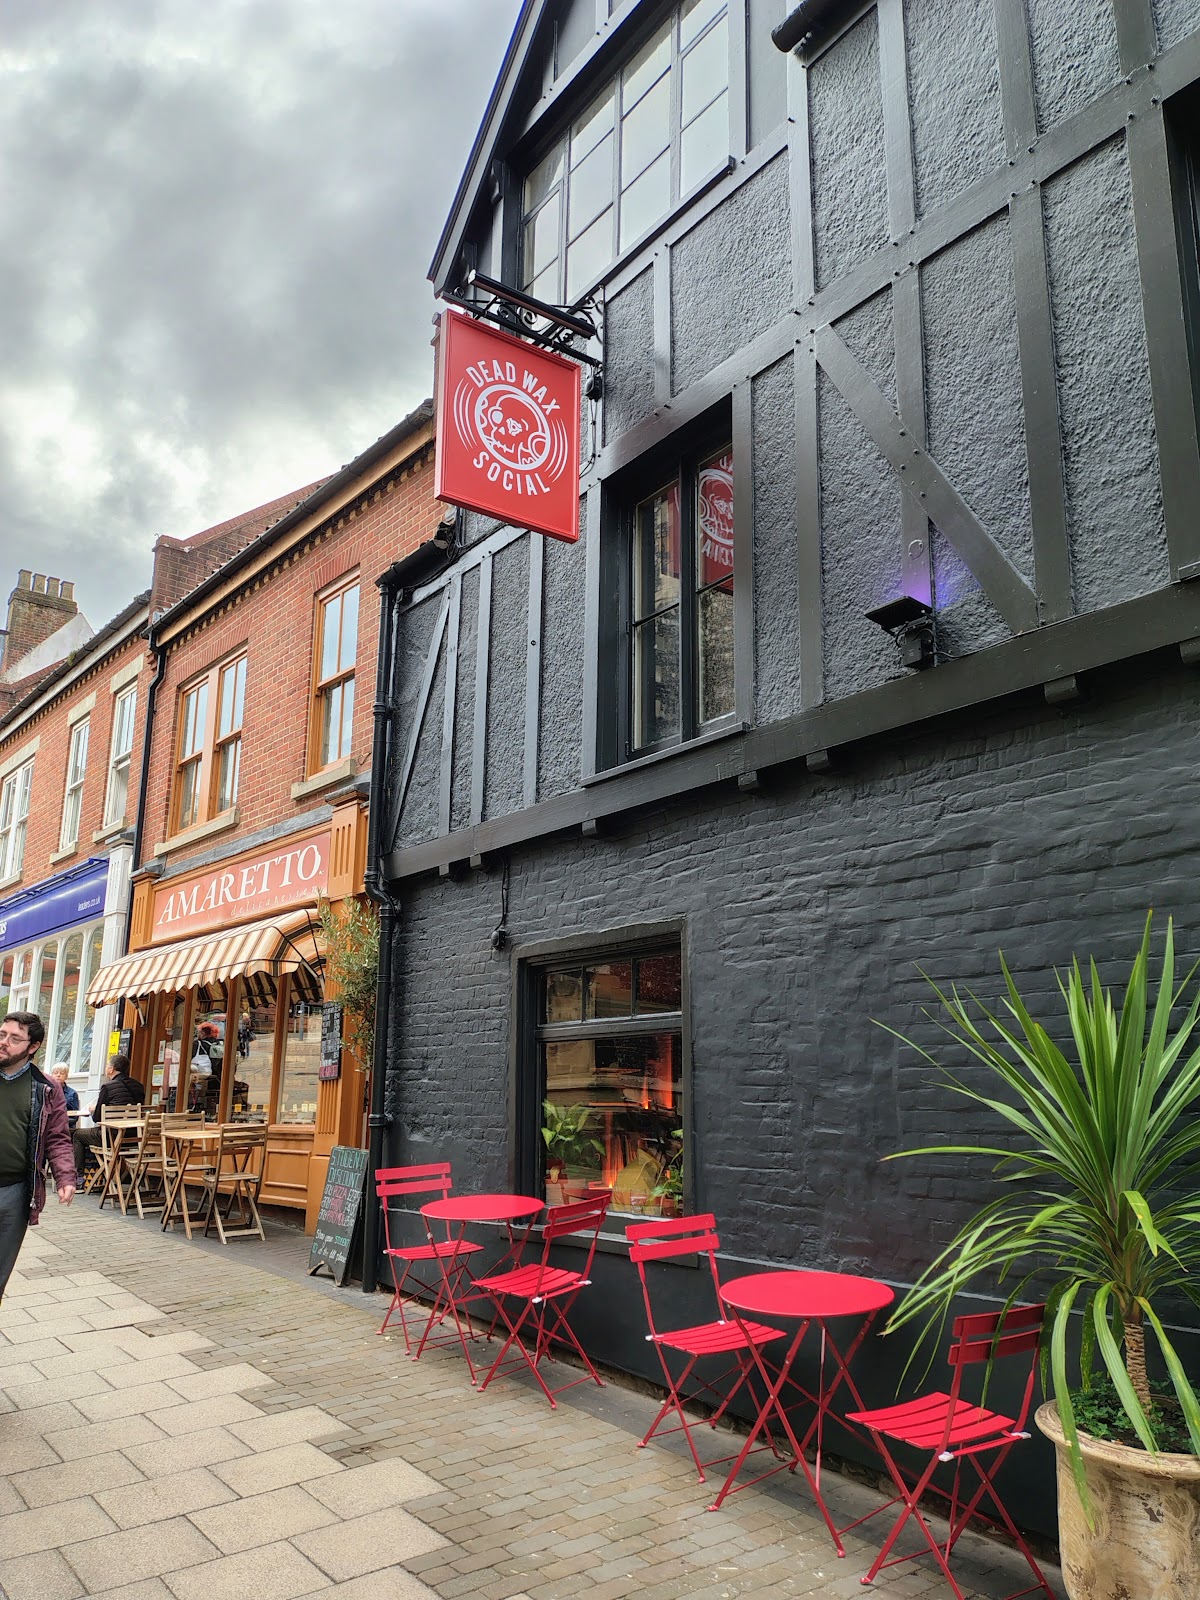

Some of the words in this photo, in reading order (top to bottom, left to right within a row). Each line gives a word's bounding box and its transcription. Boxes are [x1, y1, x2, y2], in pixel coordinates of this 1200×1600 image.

[465, 359, 516, 388] DEAD
[522, 370, 561, 416] WAX
[472, 451, 551, 496] SOCIAL
[156, 844, 322, 926] AMARETTO
[231, 885, 319, 916] delicatessen
[330, 1148, 368, 1170] STUDENT
[327, 1167, 362, 1188] DISCOUNT
[333, 1184, 348, 1200] PIZZA
